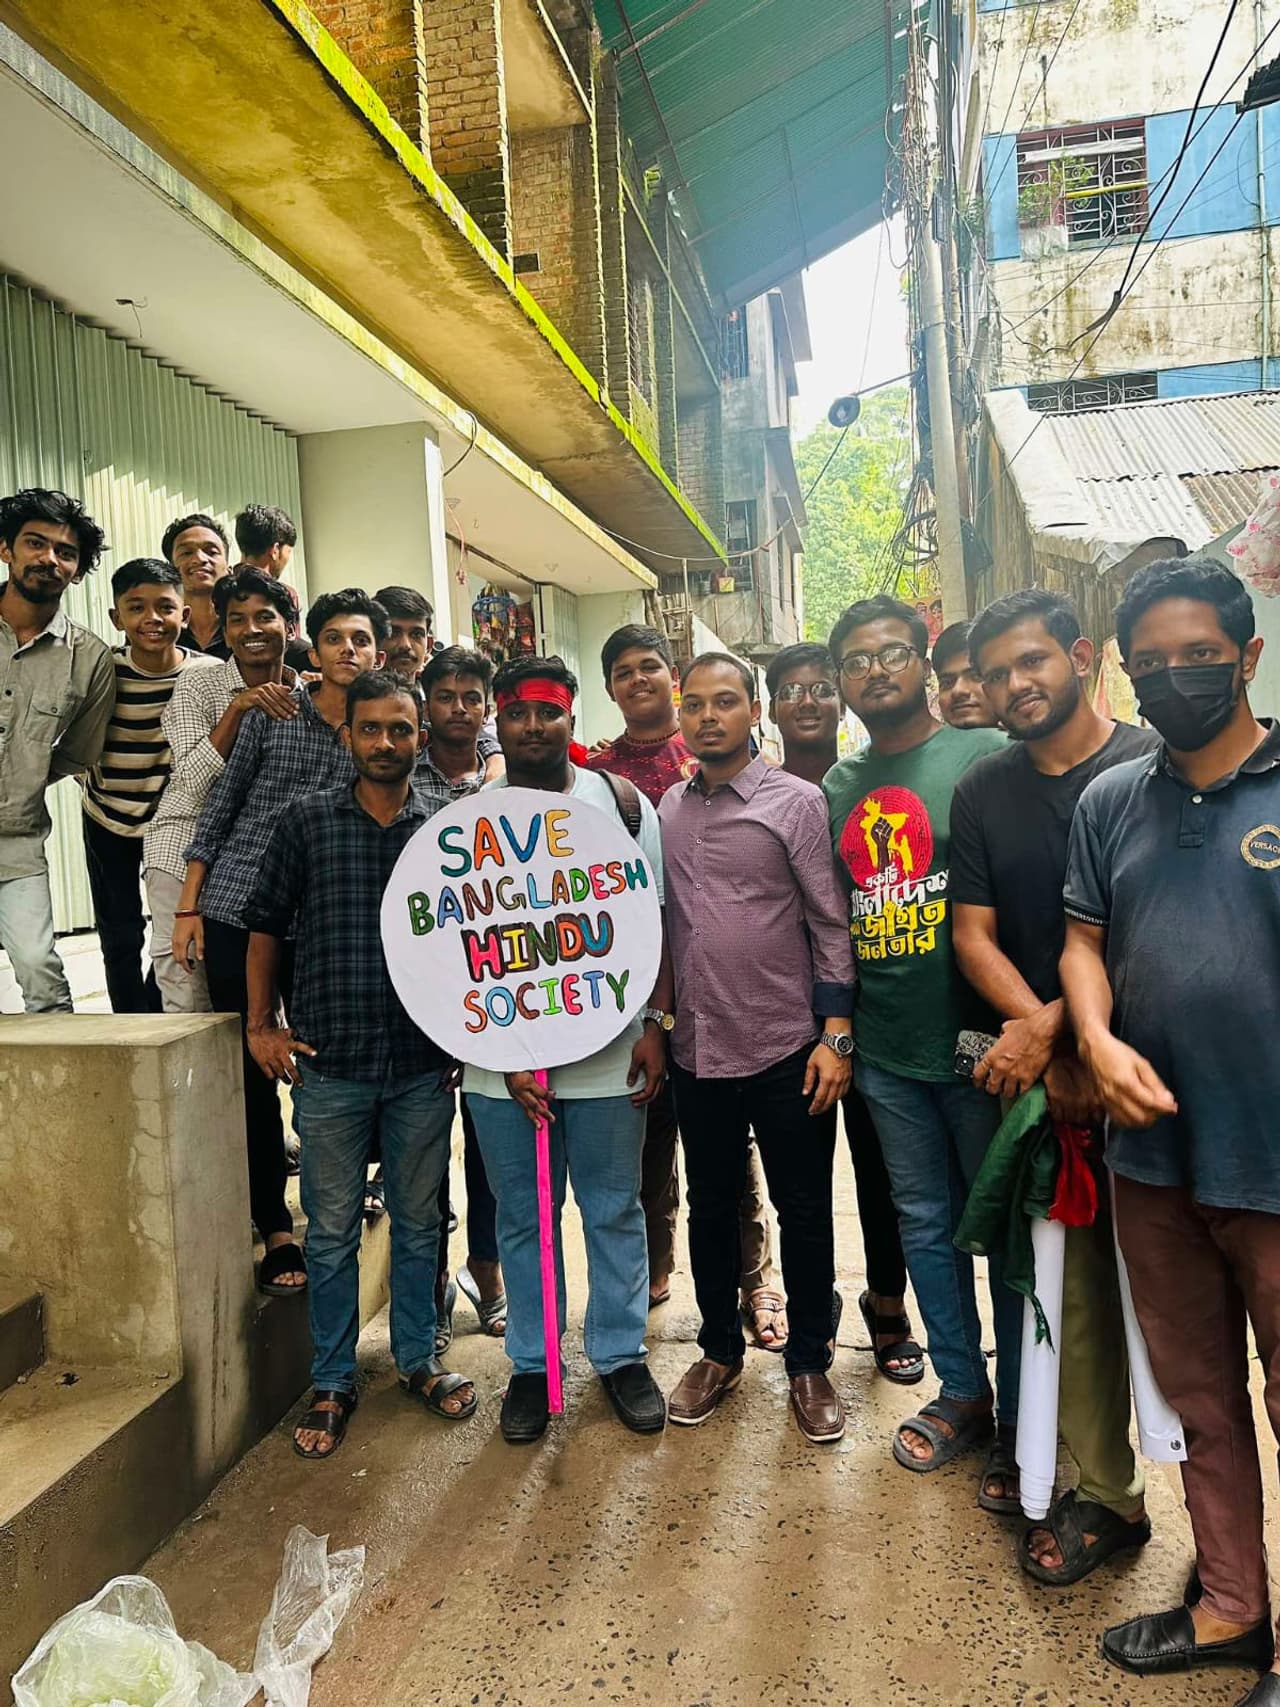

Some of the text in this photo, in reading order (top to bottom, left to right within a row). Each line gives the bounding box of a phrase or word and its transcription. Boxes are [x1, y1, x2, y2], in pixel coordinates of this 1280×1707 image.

[438, 809, 574, 877] SAVE
[407, 858, 648, 936] BANGLADESH
[461, 910, 614, 983] HINDU
[855, 927, 937, 960] জনতার
[463, 969, 630, 1034] SOCIETY
